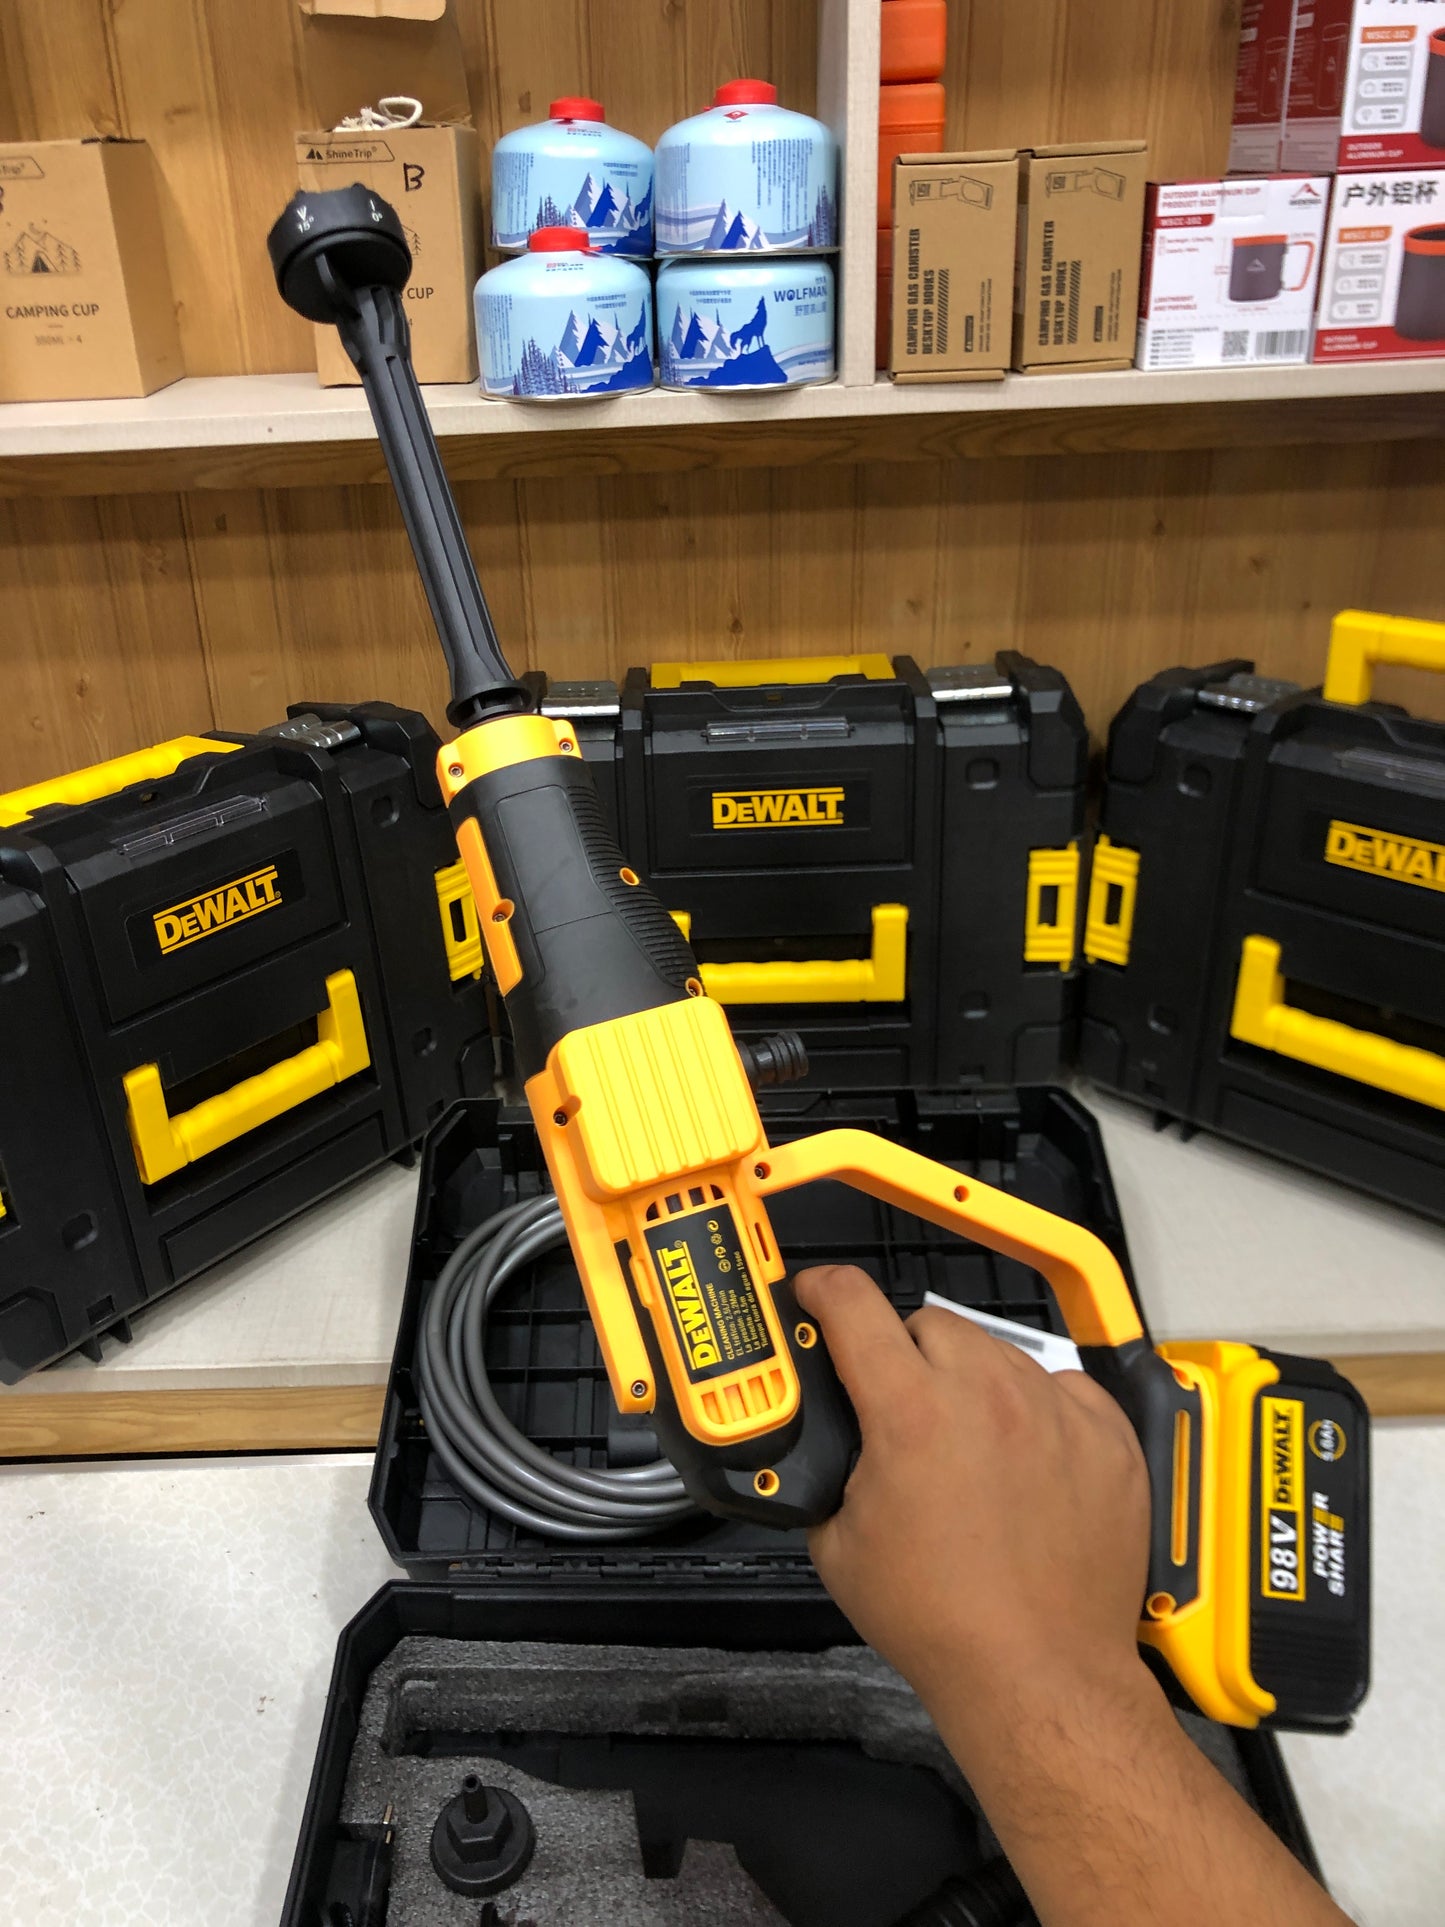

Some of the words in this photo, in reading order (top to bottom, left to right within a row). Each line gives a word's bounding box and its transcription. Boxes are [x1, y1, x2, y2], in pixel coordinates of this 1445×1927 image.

[403, 162, 425, 193] B
[1162, 189, 1199, 200] OUTDOOR
[1245, 186, 1261, 196] CUP
[1162, 200, 1198, 209] PRODUCT
[1199, 199, 1217, 207] SIZE
[1342, 180, 1439, 207] 户外铝杯
[907, 228, 920, 281] CANISTER
[1041, 220, 1055, 272] CANISTER
[406, 287, 435, 300] CUP
[923, 269, 935, 305] HOOKS
[1040, 275, 1052, 297] GAS
[1055, 260, 1067, 296] HOOKS
[773, 285, 828, 303] WOLFMAN
[907, 283, 919, 305] GAS
[5, 303, 69, 320] CAMPING
[71, 302, 101, 317] CUP
[1038, 299, 1051, 346] CAMPING
[1053, 299, 1065, 345] DESKTOP
[906, 308, 919, 355] CAMPING
[922, 308, 934, 355] DESKTOP
[704, 1282, 721, 1320] MACHINE
[716, 1316, 735, 1360] CLEANING
[745, 1343, 753, 1354] La
[753, 1340, 762, 1350] La
[755, 1321, 769, 1348] Tiempo
[1269, 1514, 1299, 1593] 98V
